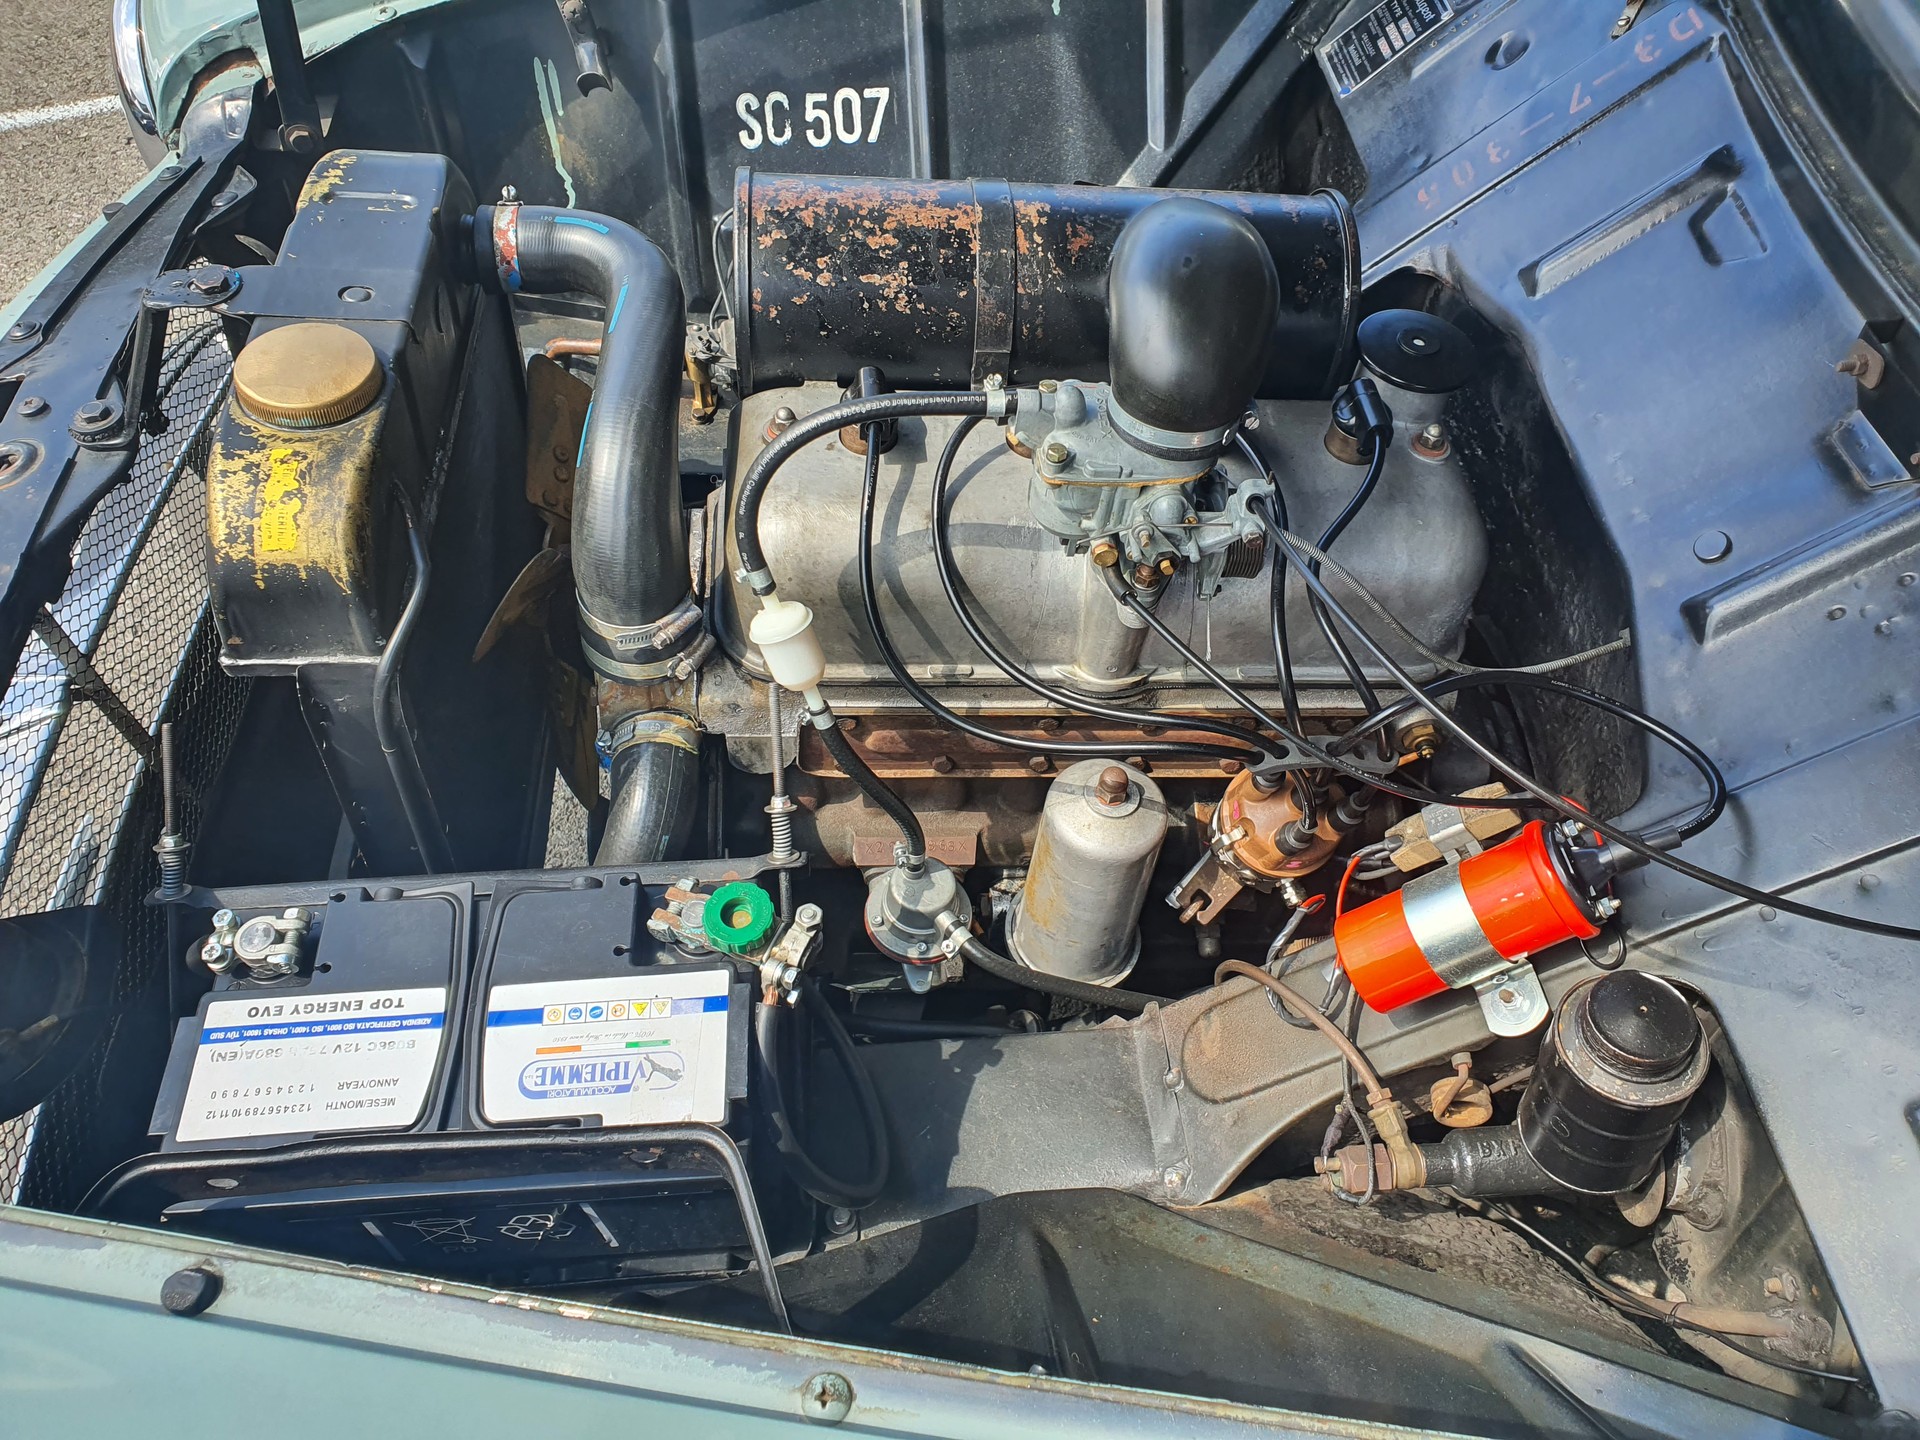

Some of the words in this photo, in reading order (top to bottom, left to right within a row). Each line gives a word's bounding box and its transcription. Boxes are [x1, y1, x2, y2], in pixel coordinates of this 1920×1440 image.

[1390, 0, 1403, 17] TYPE
[735, 91, 791, 150] SC
[804, 86, 890, 149] 507
[956, 391, 985, 405] arburant
[290, 1000, 364, 1016] ENERGY
[370, 997, 405, 1011] TOP
[247, 1004, 284, 1019] EVO
[312, 1024, 324, 1034] ISO
[344, 1022, 356, 1031] ISO
[357, 1019, 401, 1031] CERTIFICATA
[402, 1017, 432, 1028] AZIENDA
[210, 1031, 225, 1041] SUD
[226, 1030, 240, 1040] TÜV
[264, 1026, 288, 1037] OHSAS
[332, 1041, 362, 1054] 12V
[533, 1060, 647, 1091] VIPIEMME
[337, 1077, 399, 1091] ANNO/YEAR
[547, 1085, 617, 1098] ACCUMULATORI
[326, 1096, 396, 1111] MESE/MONTH
